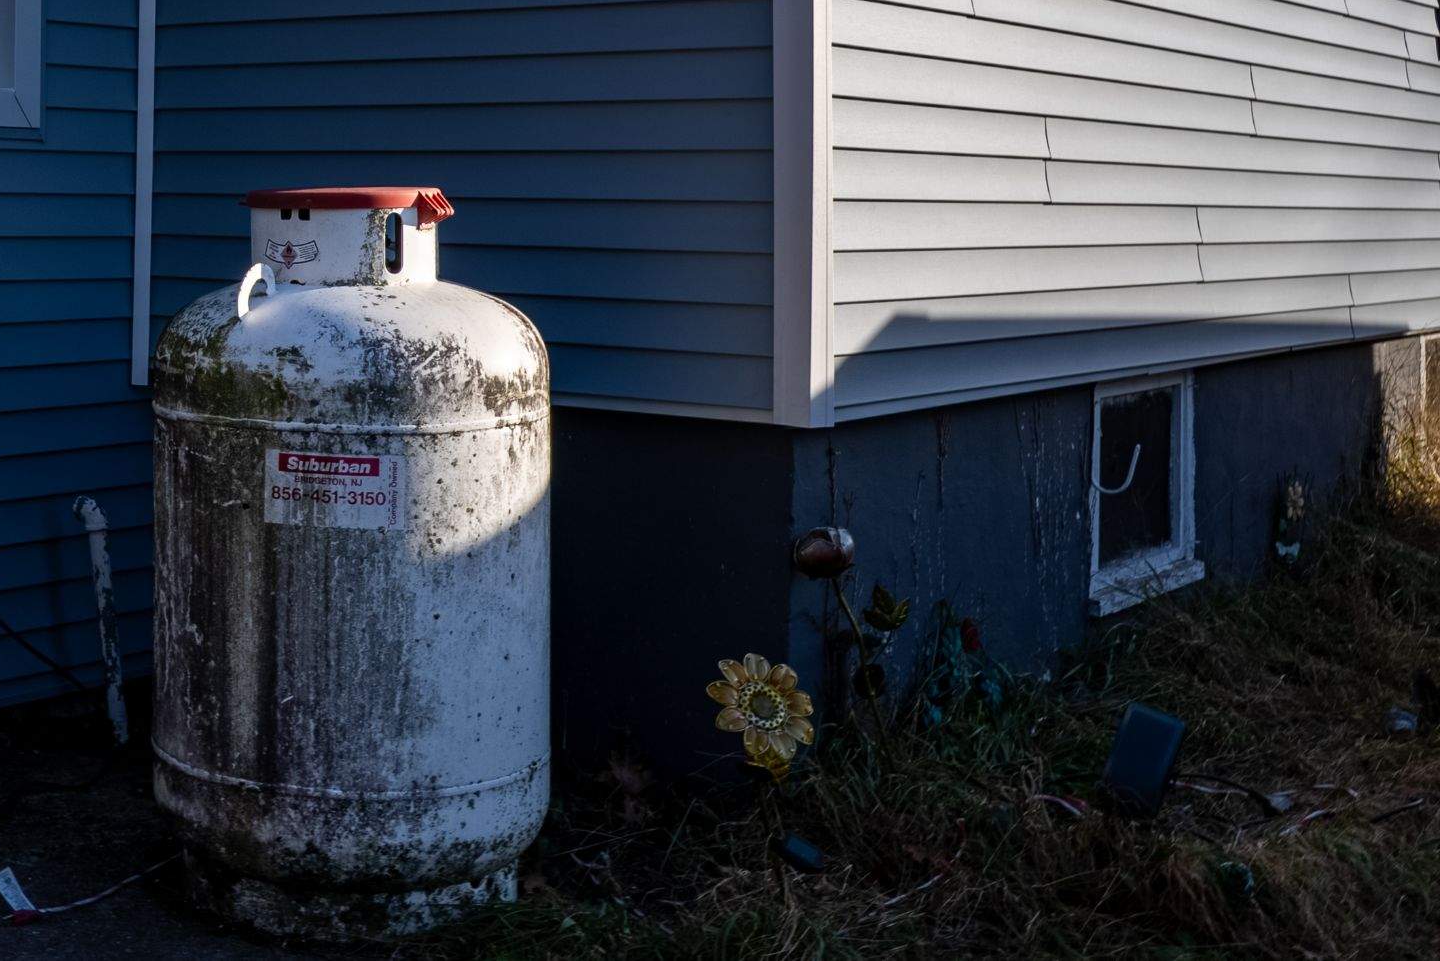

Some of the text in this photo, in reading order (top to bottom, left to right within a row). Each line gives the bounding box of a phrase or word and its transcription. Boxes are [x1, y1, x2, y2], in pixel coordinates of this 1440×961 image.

[287, 456, 371, 474] Suburban
[351, 478, 363, 487] NJ
[272, 486, 386, 506] 856-451-3150
[390, 489, 399, 525] Company
